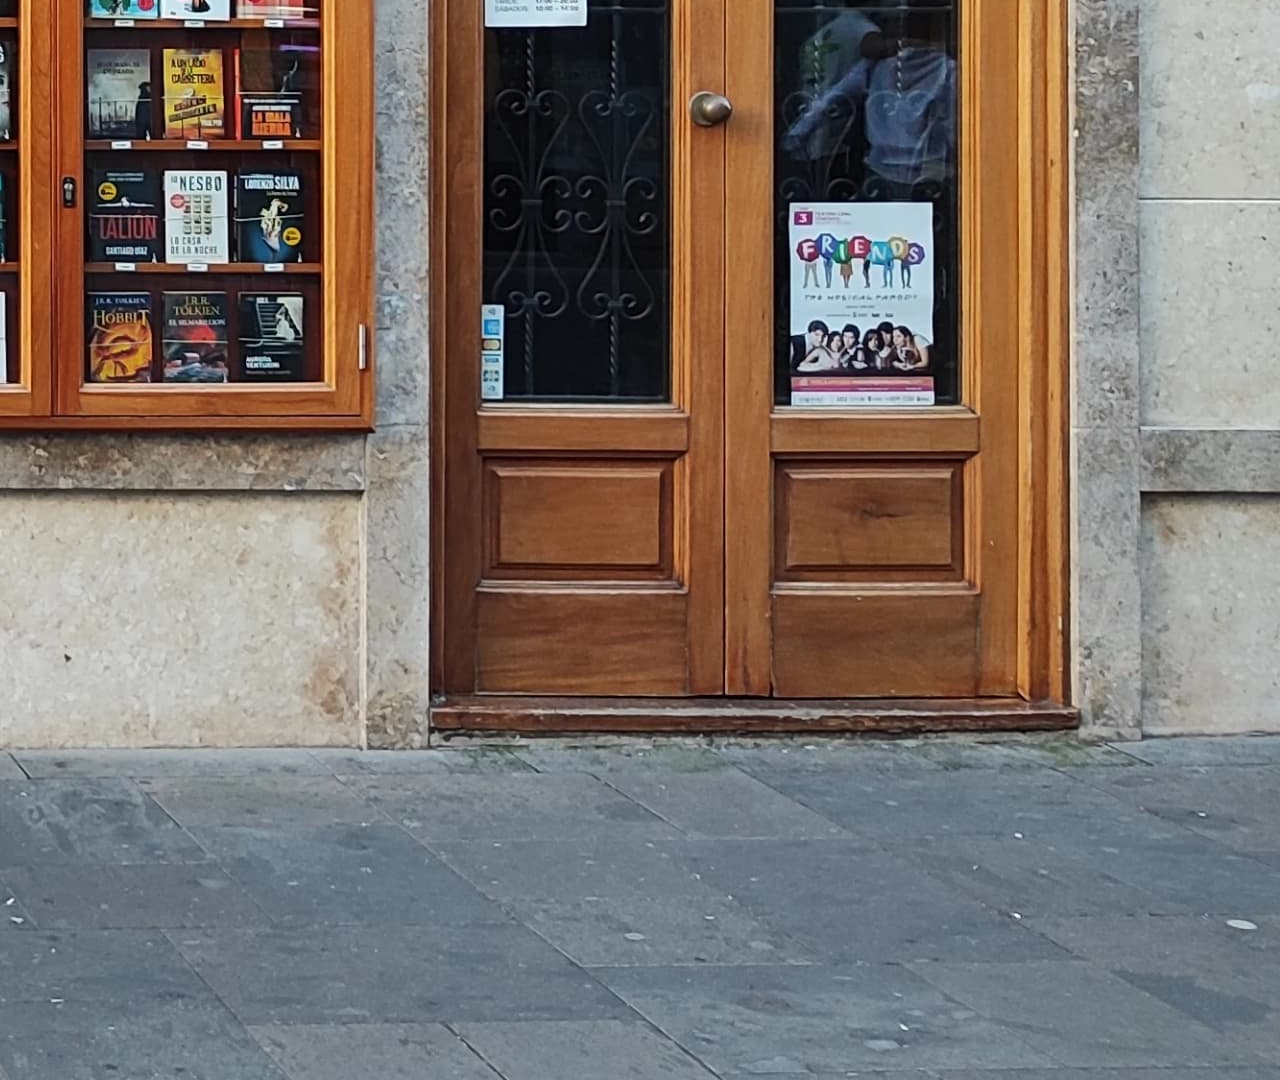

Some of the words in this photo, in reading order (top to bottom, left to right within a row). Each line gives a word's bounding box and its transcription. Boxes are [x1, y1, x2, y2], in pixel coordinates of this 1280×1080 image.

[171, 74, 216, 85] CARRETERA
[275, 176, 299, 190] SILVA
[802, 233, 920, 263] FRIENDS
[185, 296, 210, 306] J.R.R.
[174, 306, 220, 316] TOLKIEN
